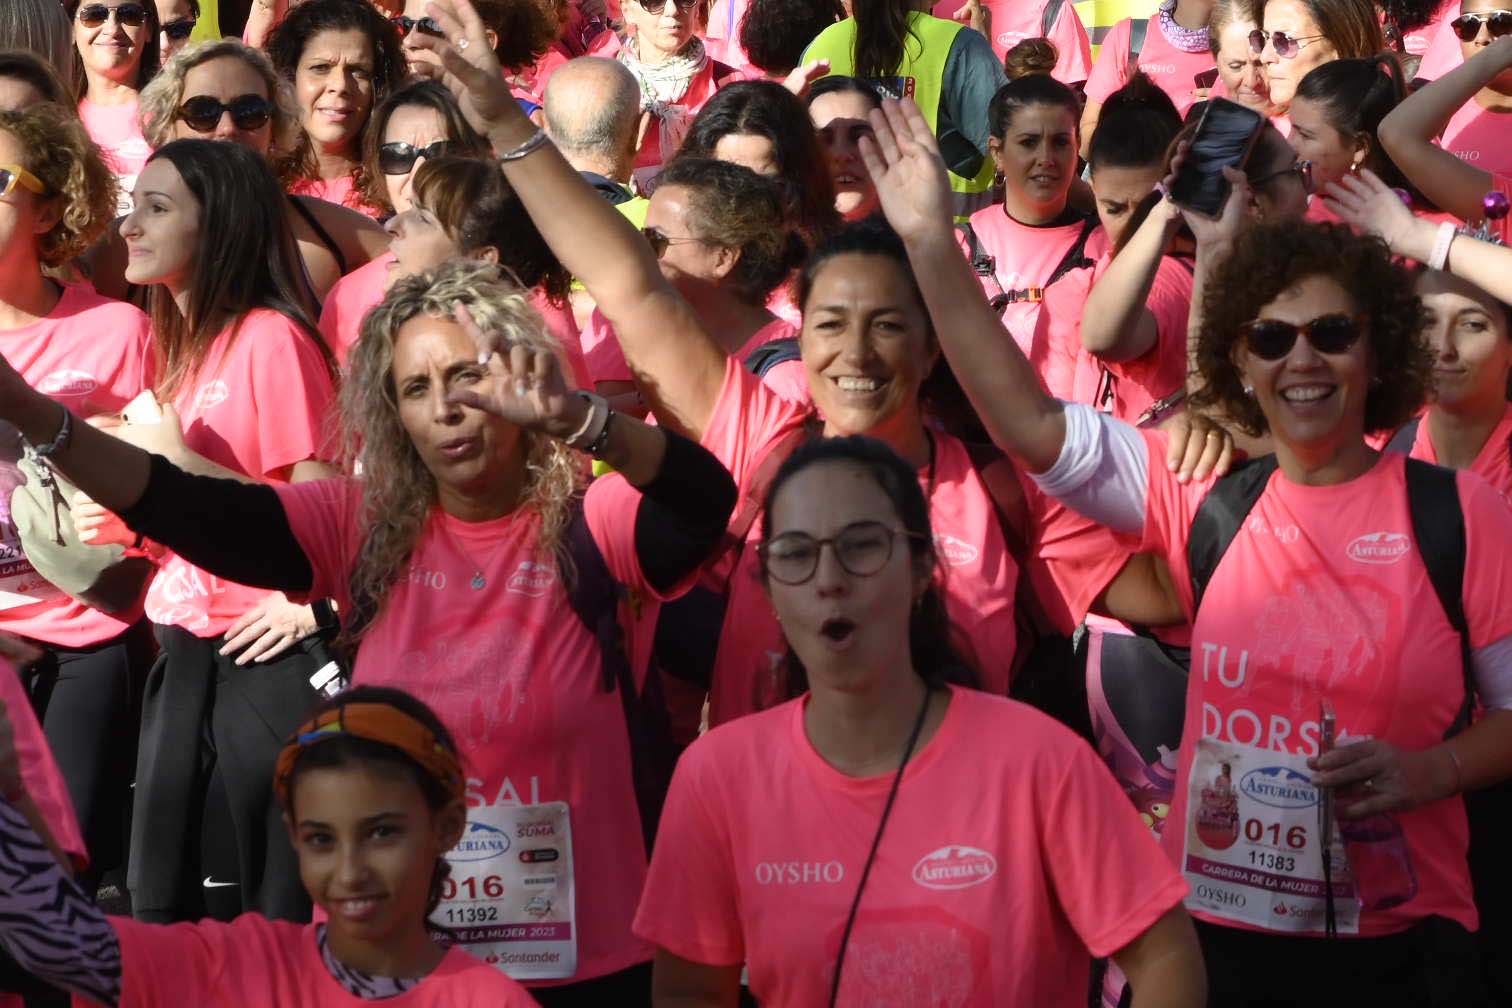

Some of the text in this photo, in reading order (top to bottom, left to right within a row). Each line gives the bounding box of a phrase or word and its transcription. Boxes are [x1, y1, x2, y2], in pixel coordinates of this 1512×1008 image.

[1202, 641, 1248, 689] TU
[1202, 702, 1320, 759] DORS
[1246, 779, 1317, 802] ASTURIANA
[517, 828, 557, 838] SUMA
[1245, 818, 1308, 849] 016
[457, 841, 505, 853] URIANA
[920, 859, 991, 881] ASTURIANA
[1249, 850, 1296, 872] 11383
[755, 861, 845, 885] OYSHO
[1202, 863, 1248, 881] CARRERA
[1279, 880, 1319, 893] MUJER
[1197, 884, 1247, 908] OYSHO
[446, 907, 498, 923] 11392
[487, 927, 526, 938] MUJER
[500, 952, 560, 964] Santander
